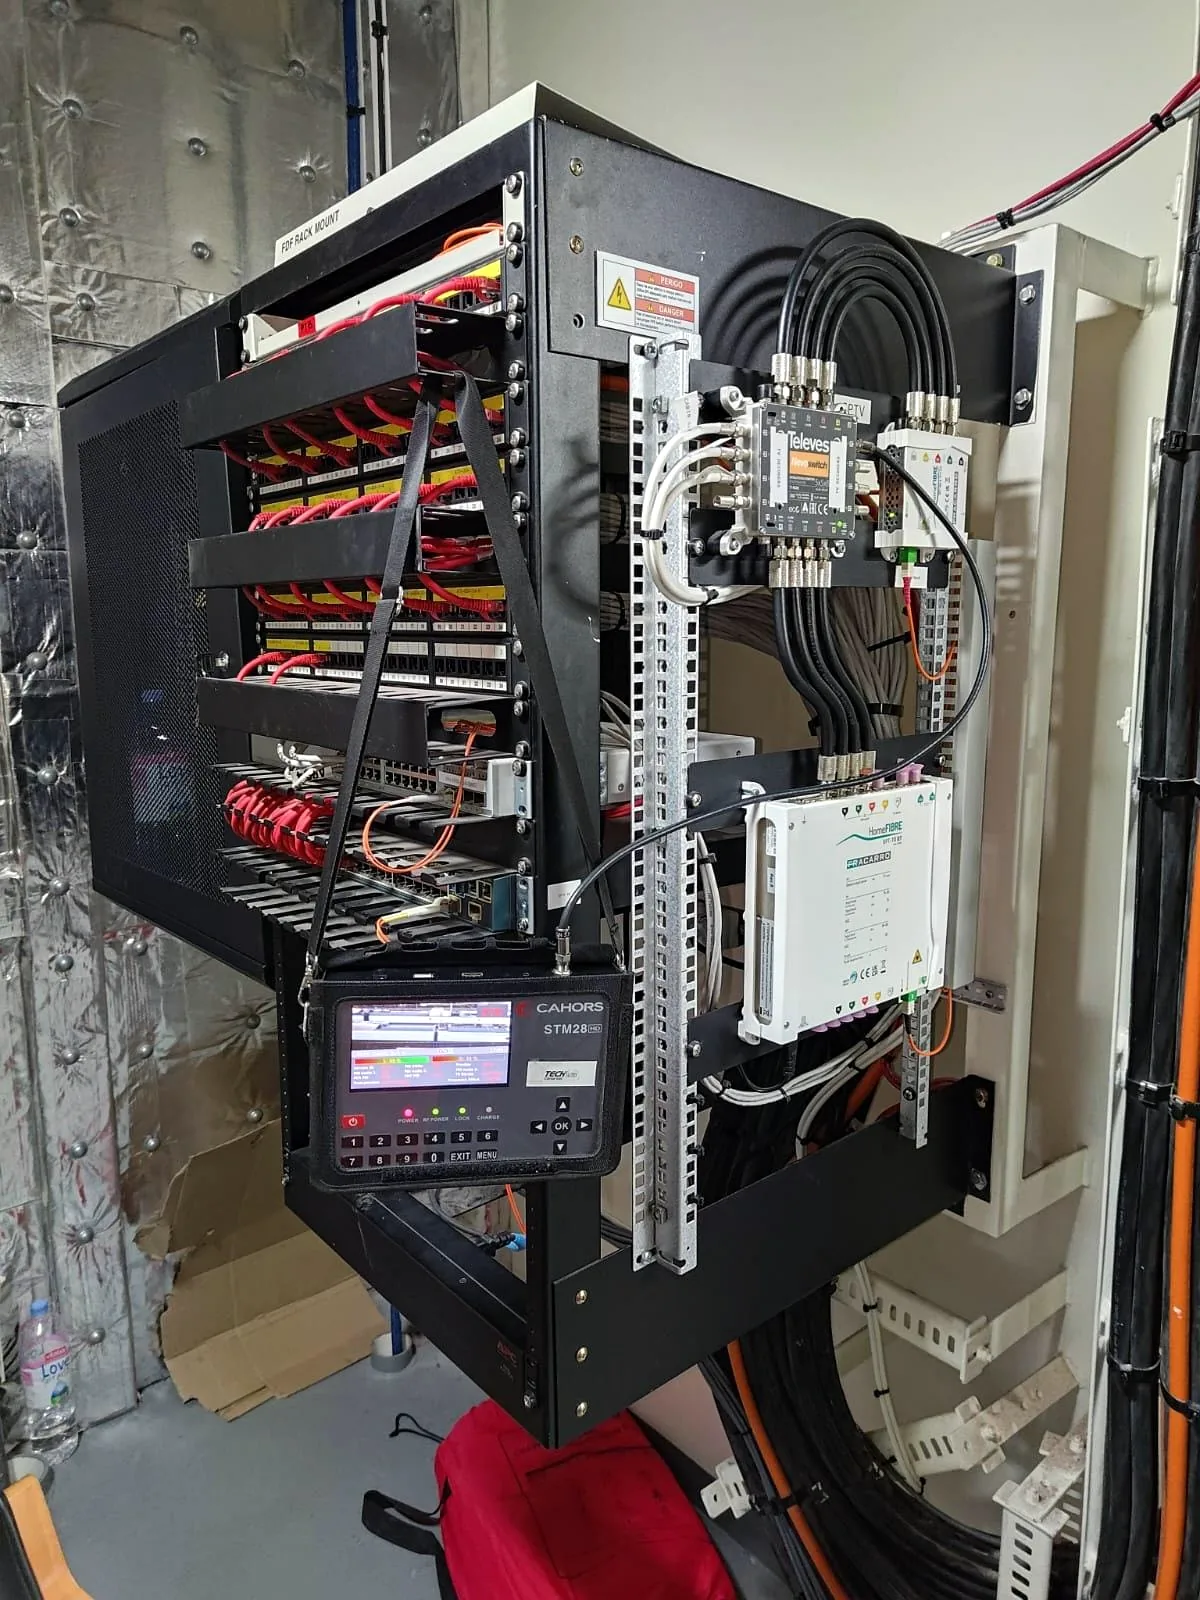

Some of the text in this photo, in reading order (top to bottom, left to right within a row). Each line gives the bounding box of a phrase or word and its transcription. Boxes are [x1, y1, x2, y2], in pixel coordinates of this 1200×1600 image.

[281, 209, 340, 254] FDF RACK MOUNT
[660, 276, 683, 288] PERIGO
[659, 304, 684, 317] DANGER
[787, 430, 830, 453] Televes
[868, 820, 903, 836] HomeFIBRE
[536, 1001, 604, 1014] CAHORS
[544, 1024, 588, 1035] STM28
[554, 1120, 569, 1131] OK
[404, 1135, 411, 1144] 3
[431, 1134, 438, 1142] 4
[458, 1133, 465, 1141] 5
[485, 1132, 491, 1140] 6
[351, 1138, 356, 1146] 1
[377, 1137, 384, 1145] 2
[404, 1155, 410, 1163] 9
[450, 1152, 471, 1161] EXIT
[476, 1151, 497, 1160] MENU
[349, 1158, 355, 1166] 7
[377, 1156, 383, 1165] 8
[41, 1356, 70, 1378] Love
